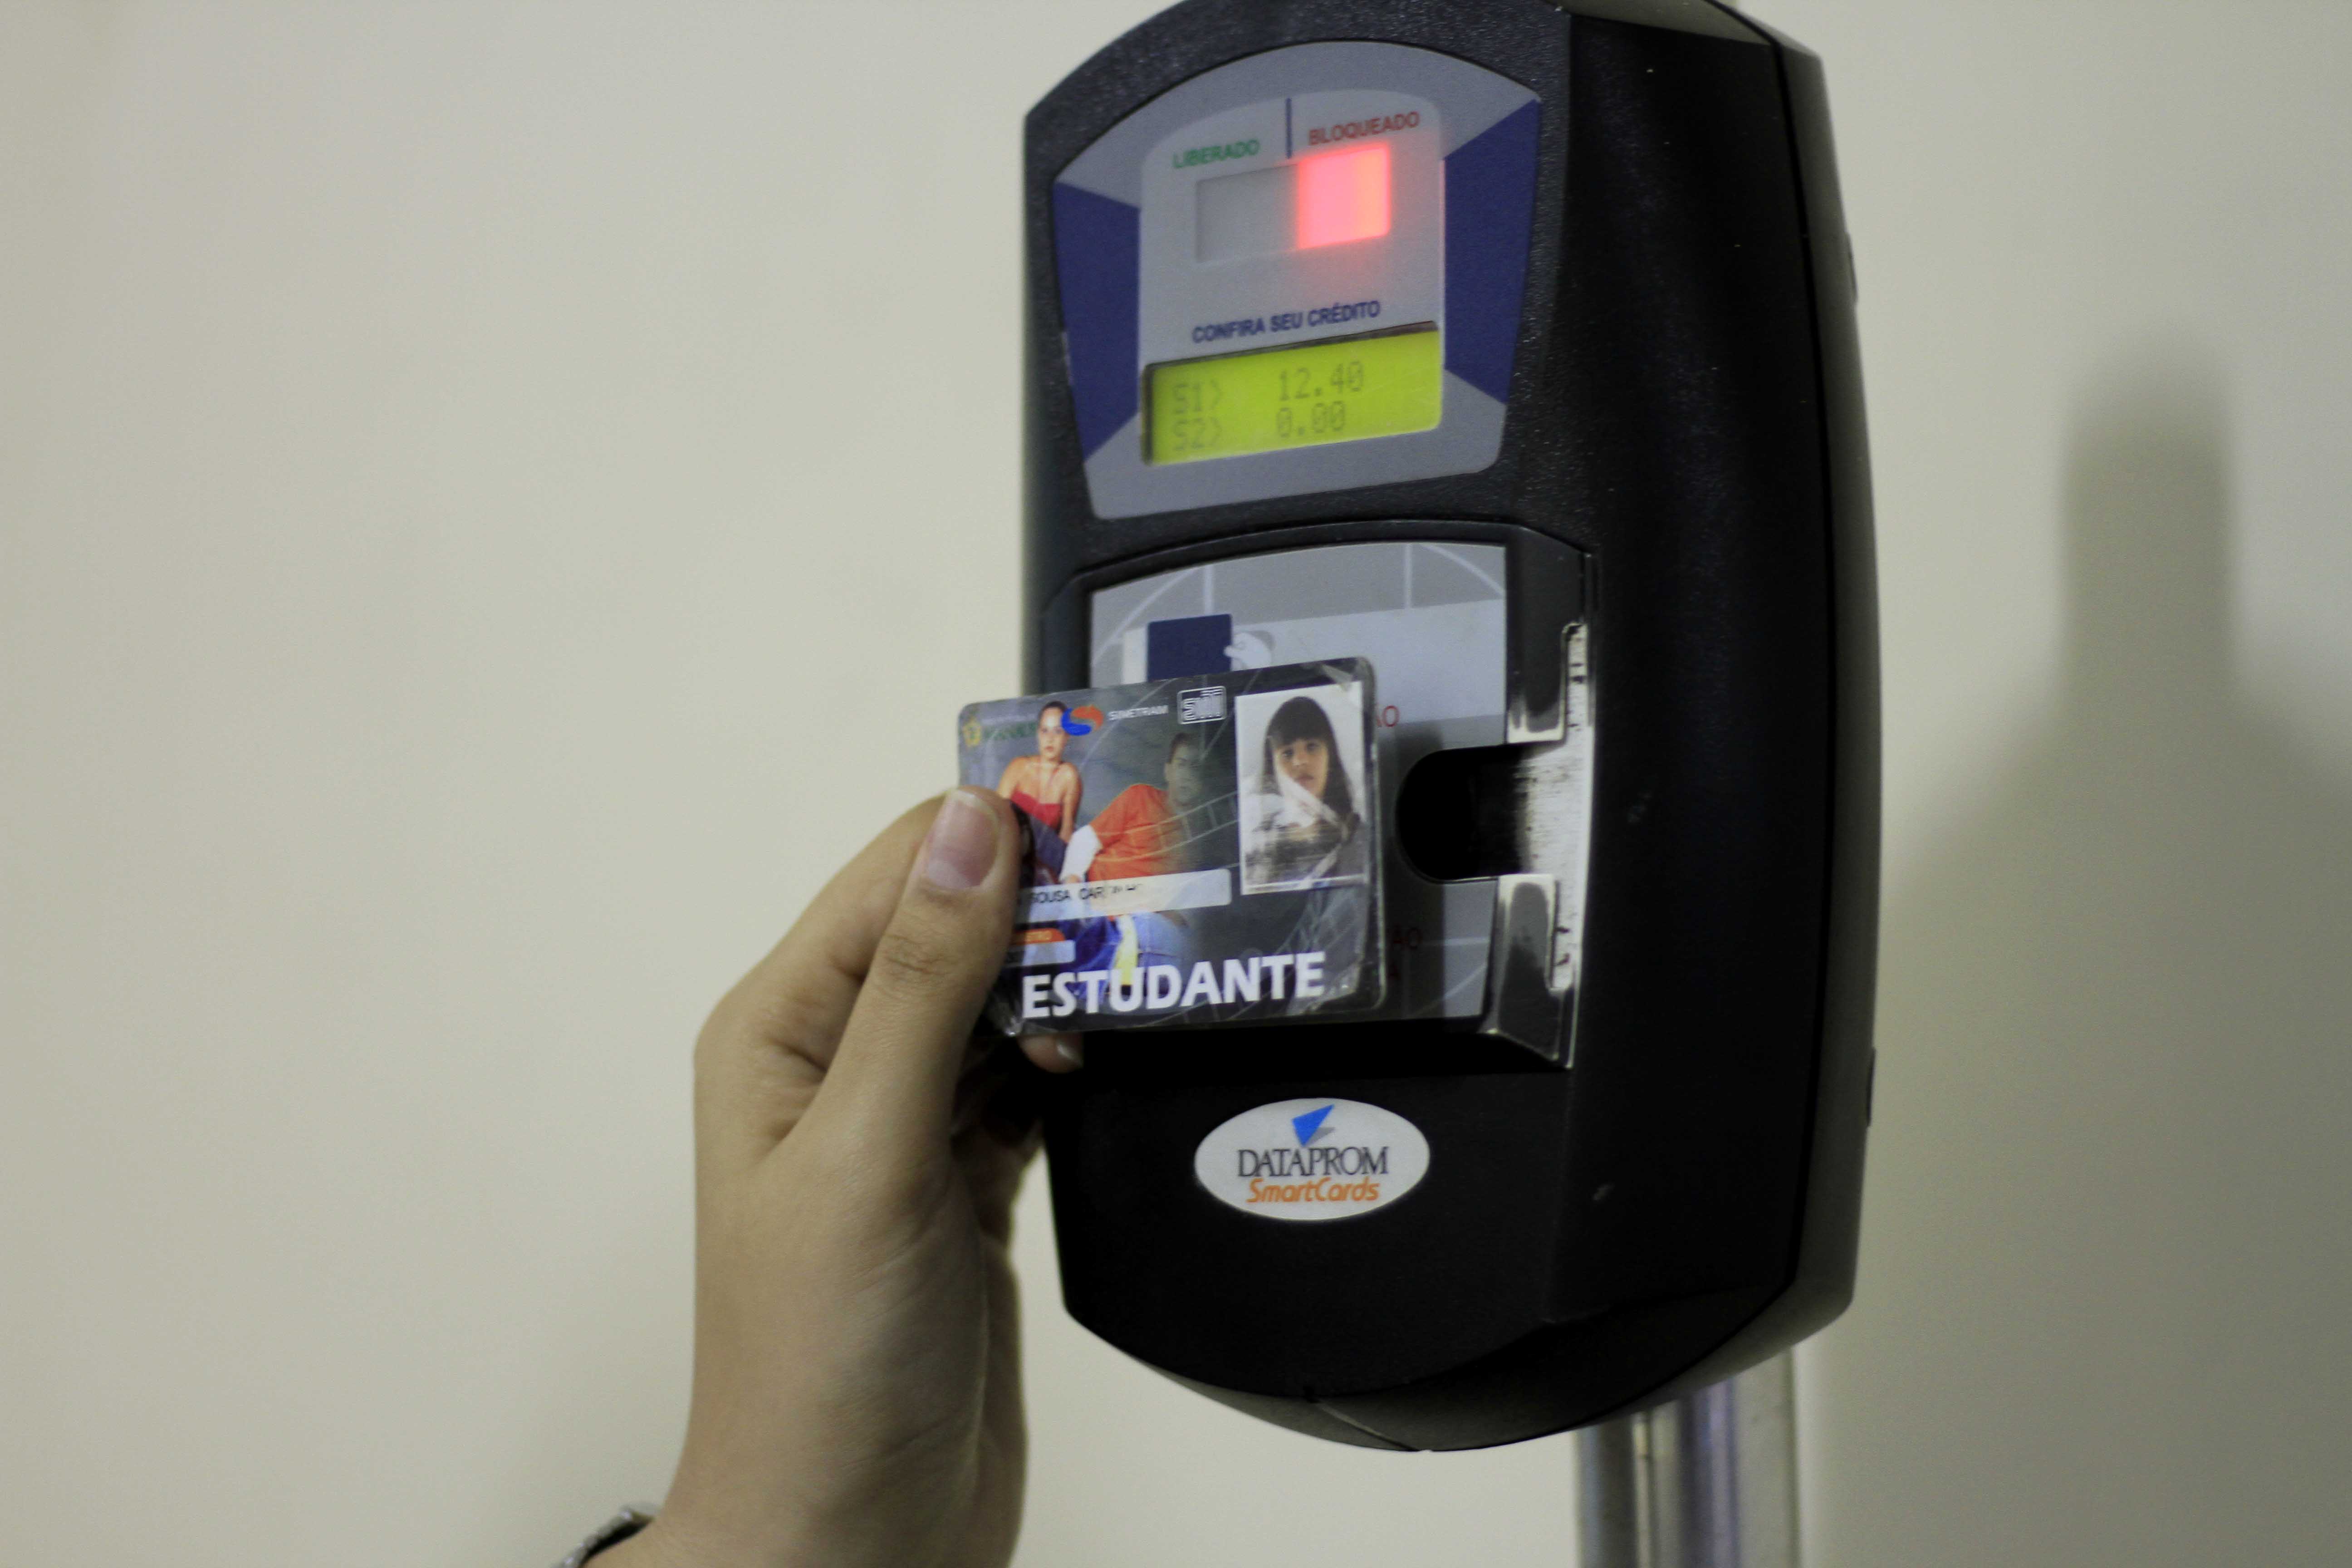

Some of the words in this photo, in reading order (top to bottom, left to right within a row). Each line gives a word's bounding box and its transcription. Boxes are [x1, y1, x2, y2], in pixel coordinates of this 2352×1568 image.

[1308, 111, 1420, 146] BLOQUEADO
[1172, 139, 1260, 168] LIBERADO
[1192, 318, 1265, 343] CONFIRA
[1271, 312, 1303, 332] SEU
[1308, 300, 1380, 327] CRÉDITO
[1278, 361, 1364, 401] 12.40
[1276, 400, 1346, 438] 0.00
[1022, 951, 1326, 1018] ESTUDANTE
[1237, 1146, 1389, 1177] DATAPROM
[1246, 1176, 1381, 1203] SmartCards
